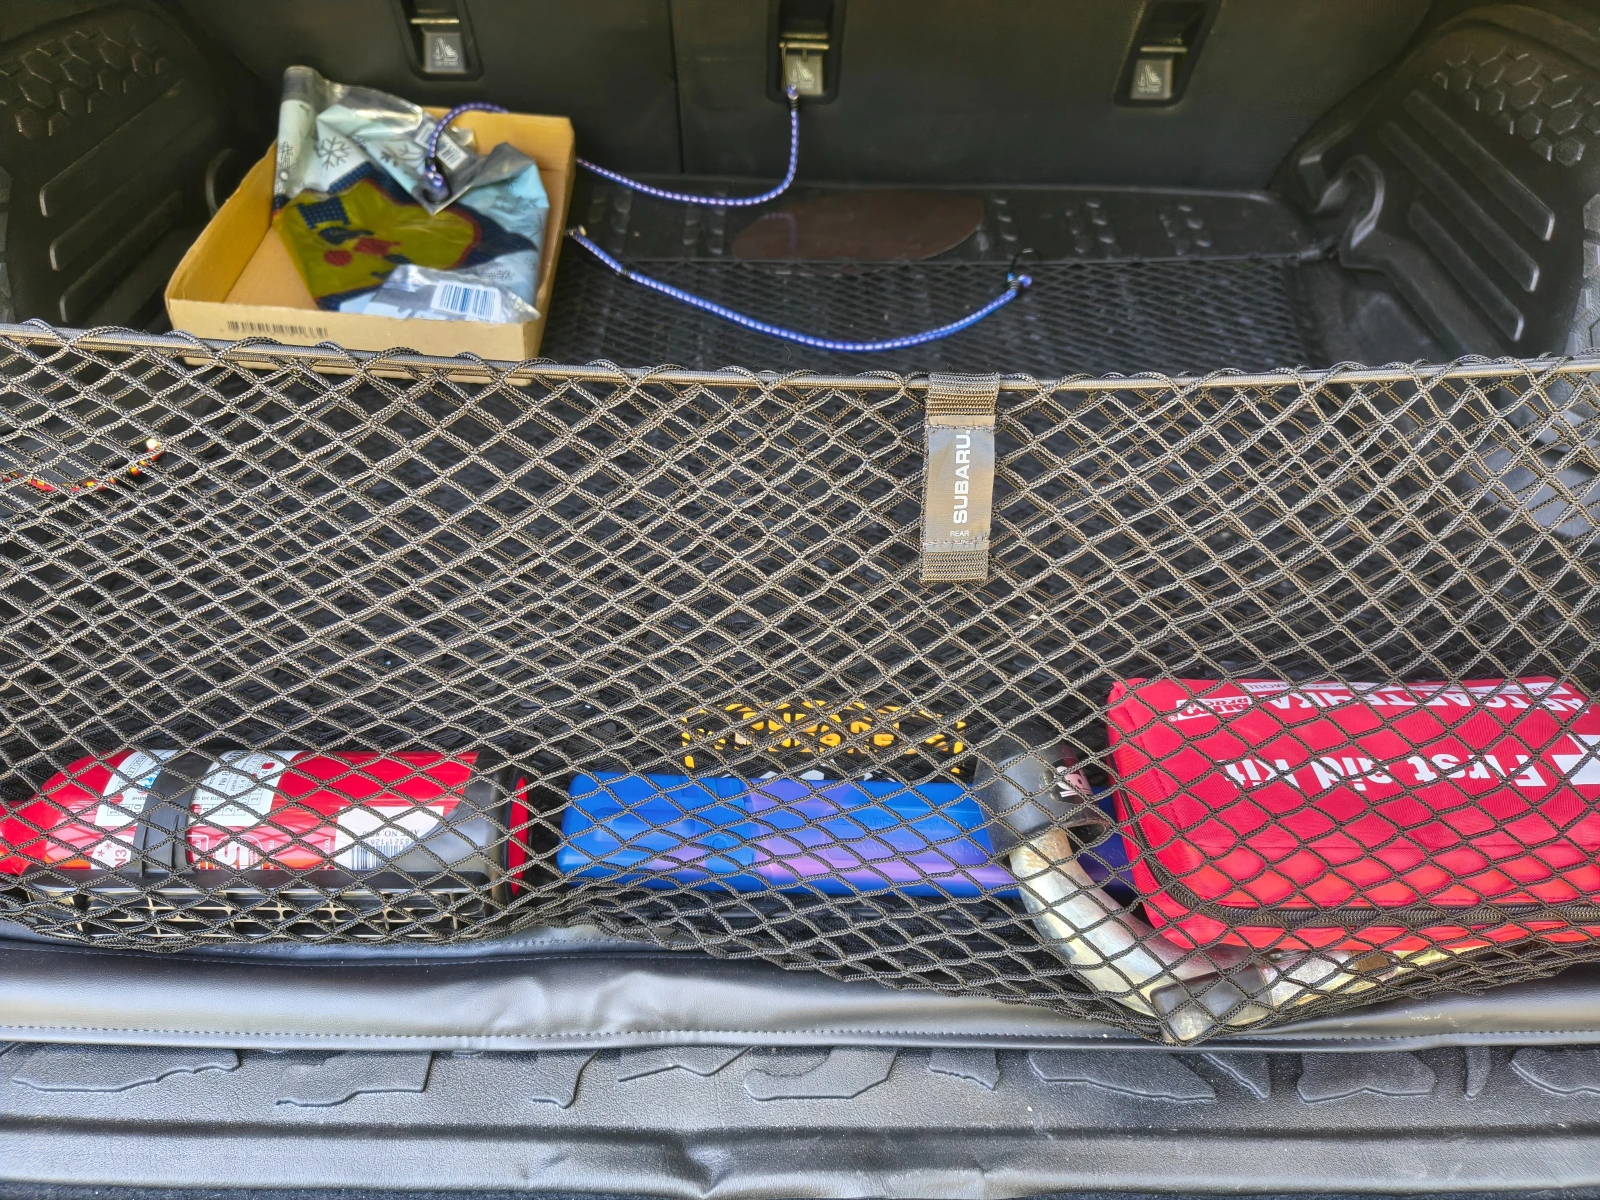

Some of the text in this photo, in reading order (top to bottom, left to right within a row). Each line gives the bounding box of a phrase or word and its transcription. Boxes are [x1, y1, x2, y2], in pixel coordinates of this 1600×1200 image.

[953, 433, 971, 524] SUBARU
[1310, 756, 1394, 791] aid
[1406, 753, 1547, 787] First
